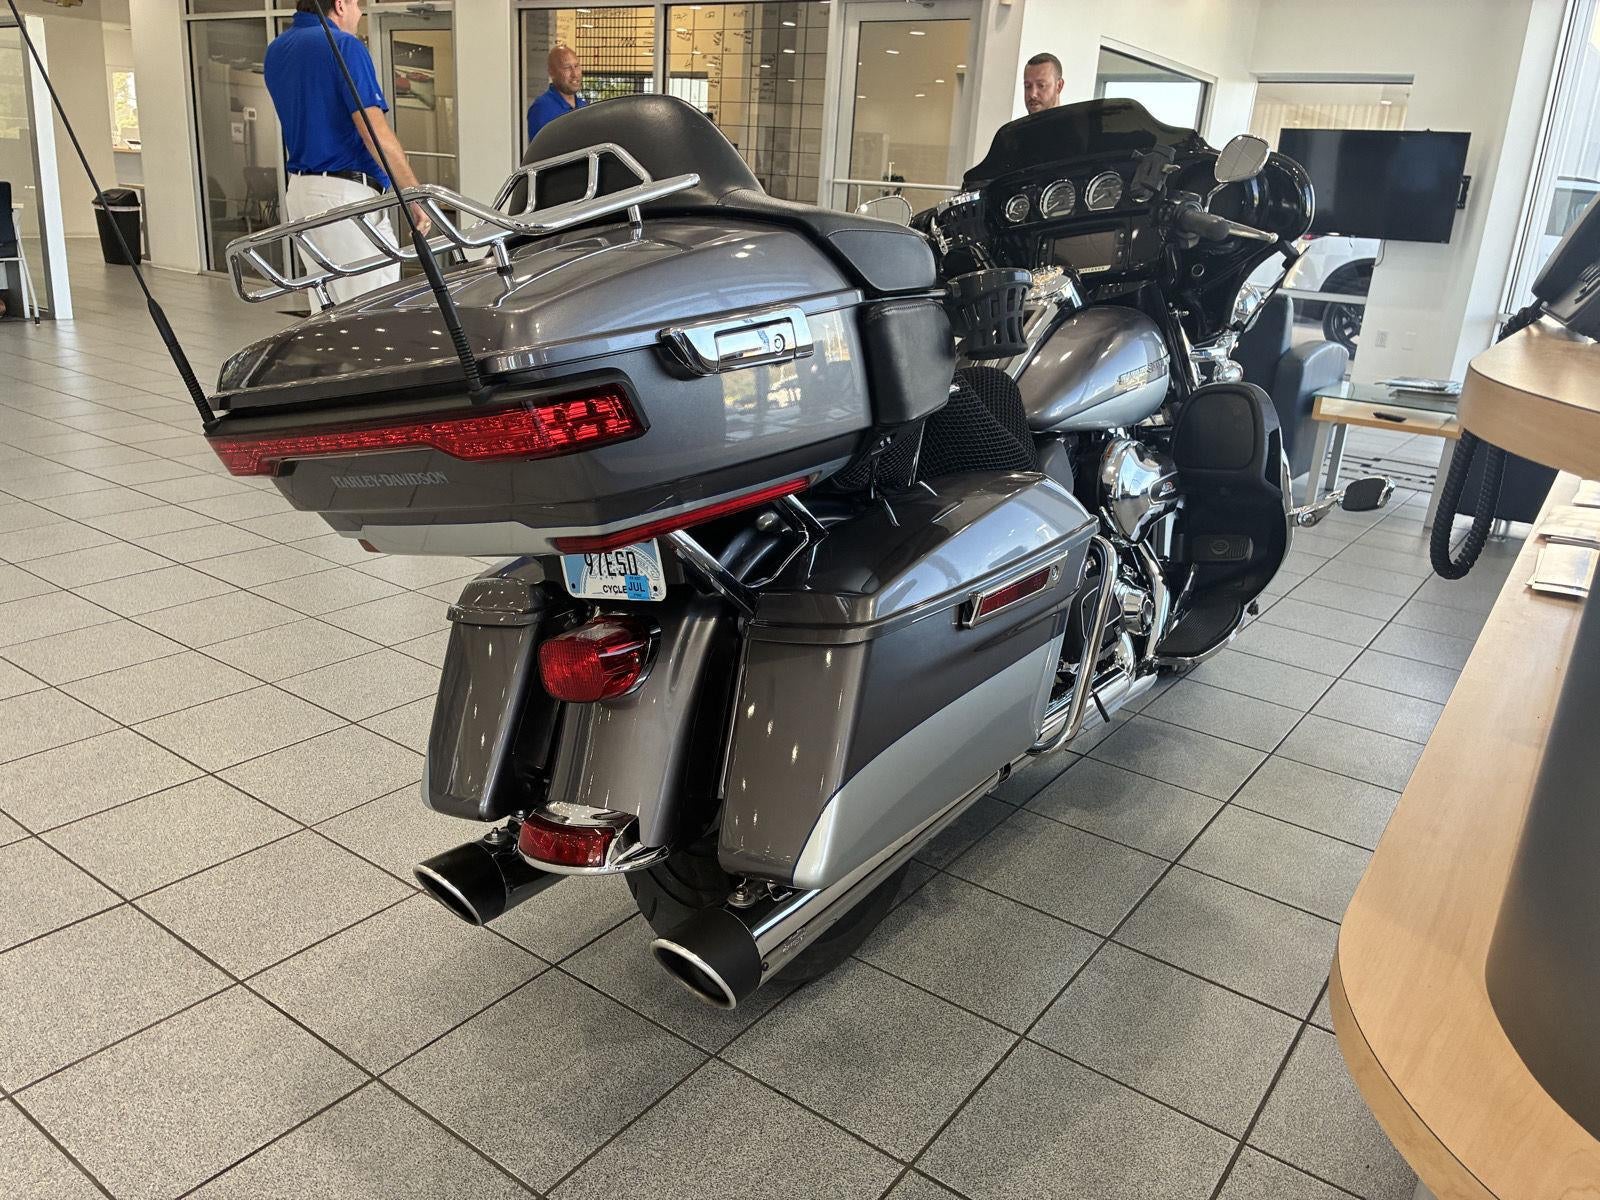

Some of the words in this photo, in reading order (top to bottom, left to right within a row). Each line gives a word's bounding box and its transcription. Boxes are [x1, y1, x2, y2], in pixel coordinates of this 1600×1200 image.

[330, 471, 449, 488] HARLEY-DAVIDSON
[602, 584, 627, 594] CYCLE
[628, 582, 645, 592] JUL
